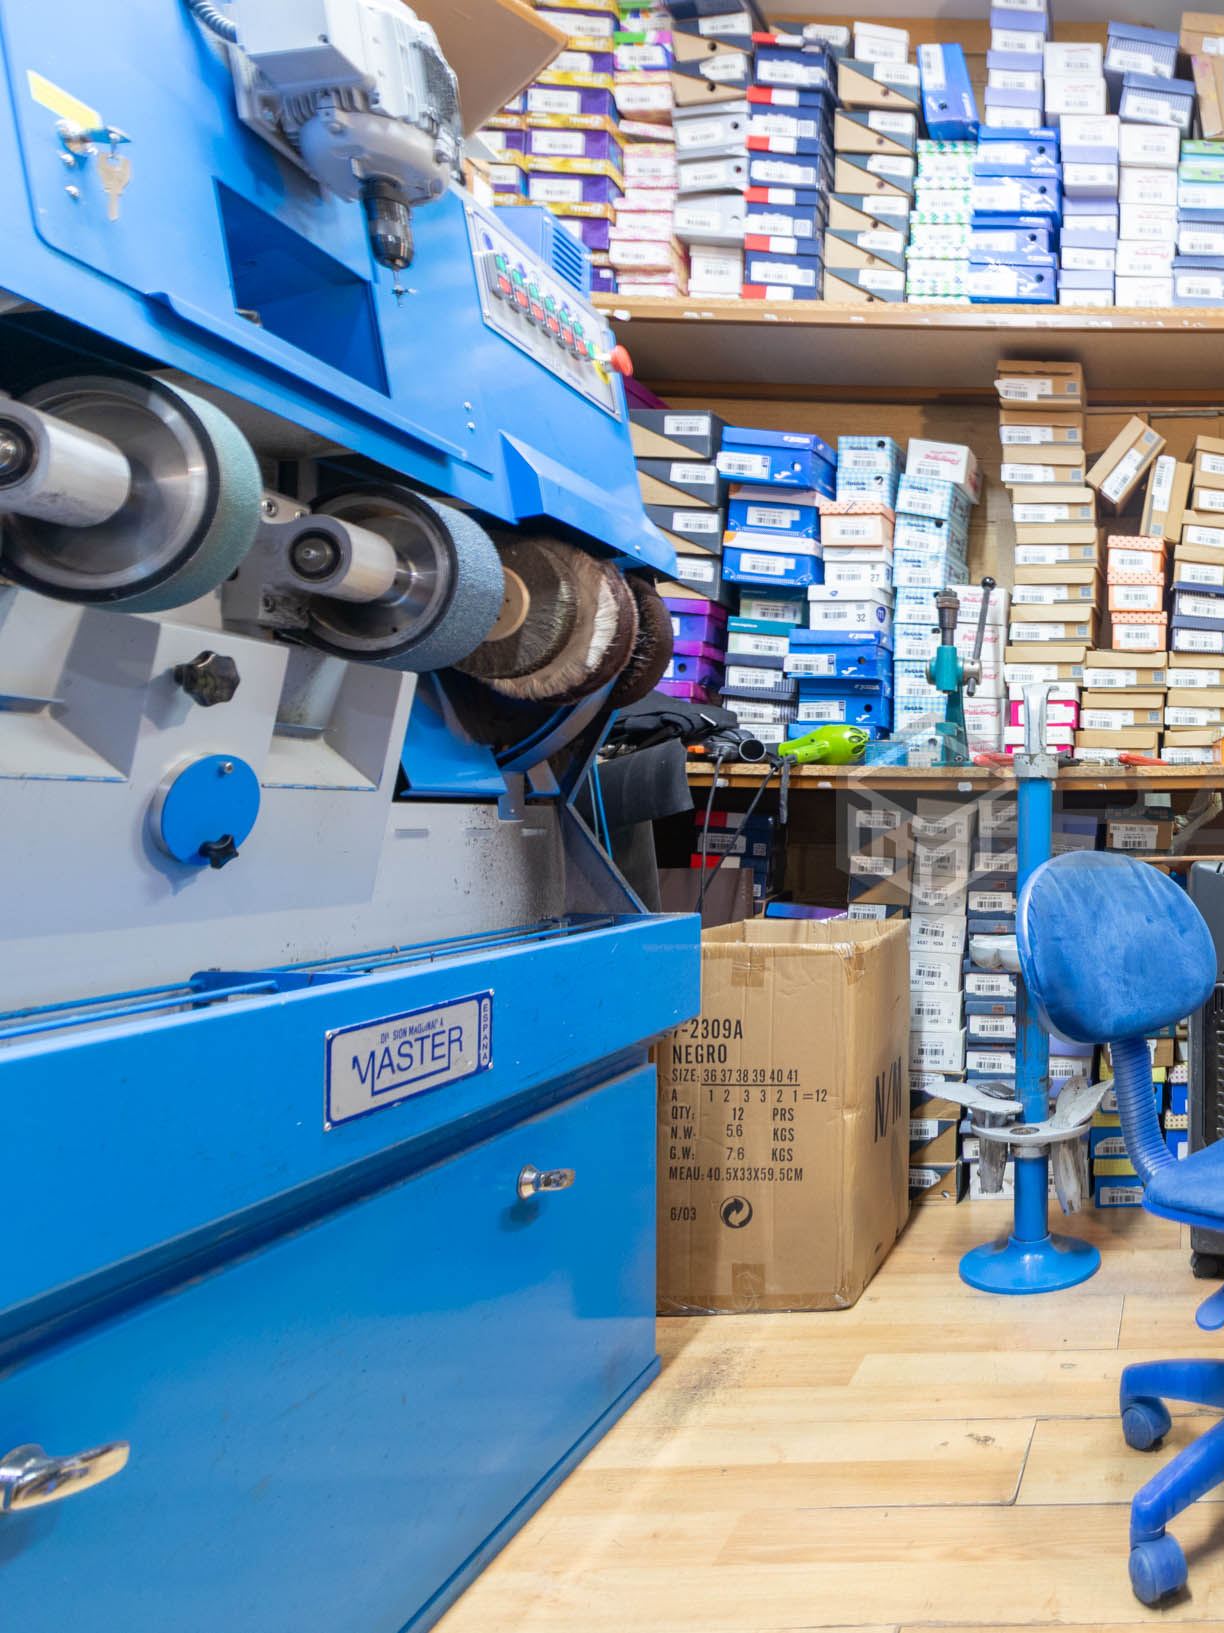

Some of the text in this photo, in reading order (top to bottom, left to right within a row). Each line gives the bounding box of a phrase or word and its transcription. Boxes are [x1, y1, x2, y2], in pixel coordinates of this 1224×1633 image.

[856, 613, 866, 623] 32
[352, 1025, 463, 1097] MASTER
[672, 1044, 727, 1065] NEGRO
[671, 1068, 798, 1083] SIZE: 36 37 38 39 40 41
[671, 1088, 678, 1102] A
[708, 1089, 714, 1102] 1
[723, 1089, 730, 1102] 2
[743, 1089, 750, 1102] 3
[760, 1089, 767, 1102] 3
[776, 1089, 783, 1103] 2
[793, 1089, 798, 1103] 1
[671, 1105, 794, 1121] QTY: 12 PRS
[726, 1123, 743, 1138] 5.6
[773, 1127, 795, 1142] KGS
[669, 1146, 793, 1162] G.W: 7.6 KGS
[668, 1166, 803, 1182] MEAU: 40.5X33X59.5CM
